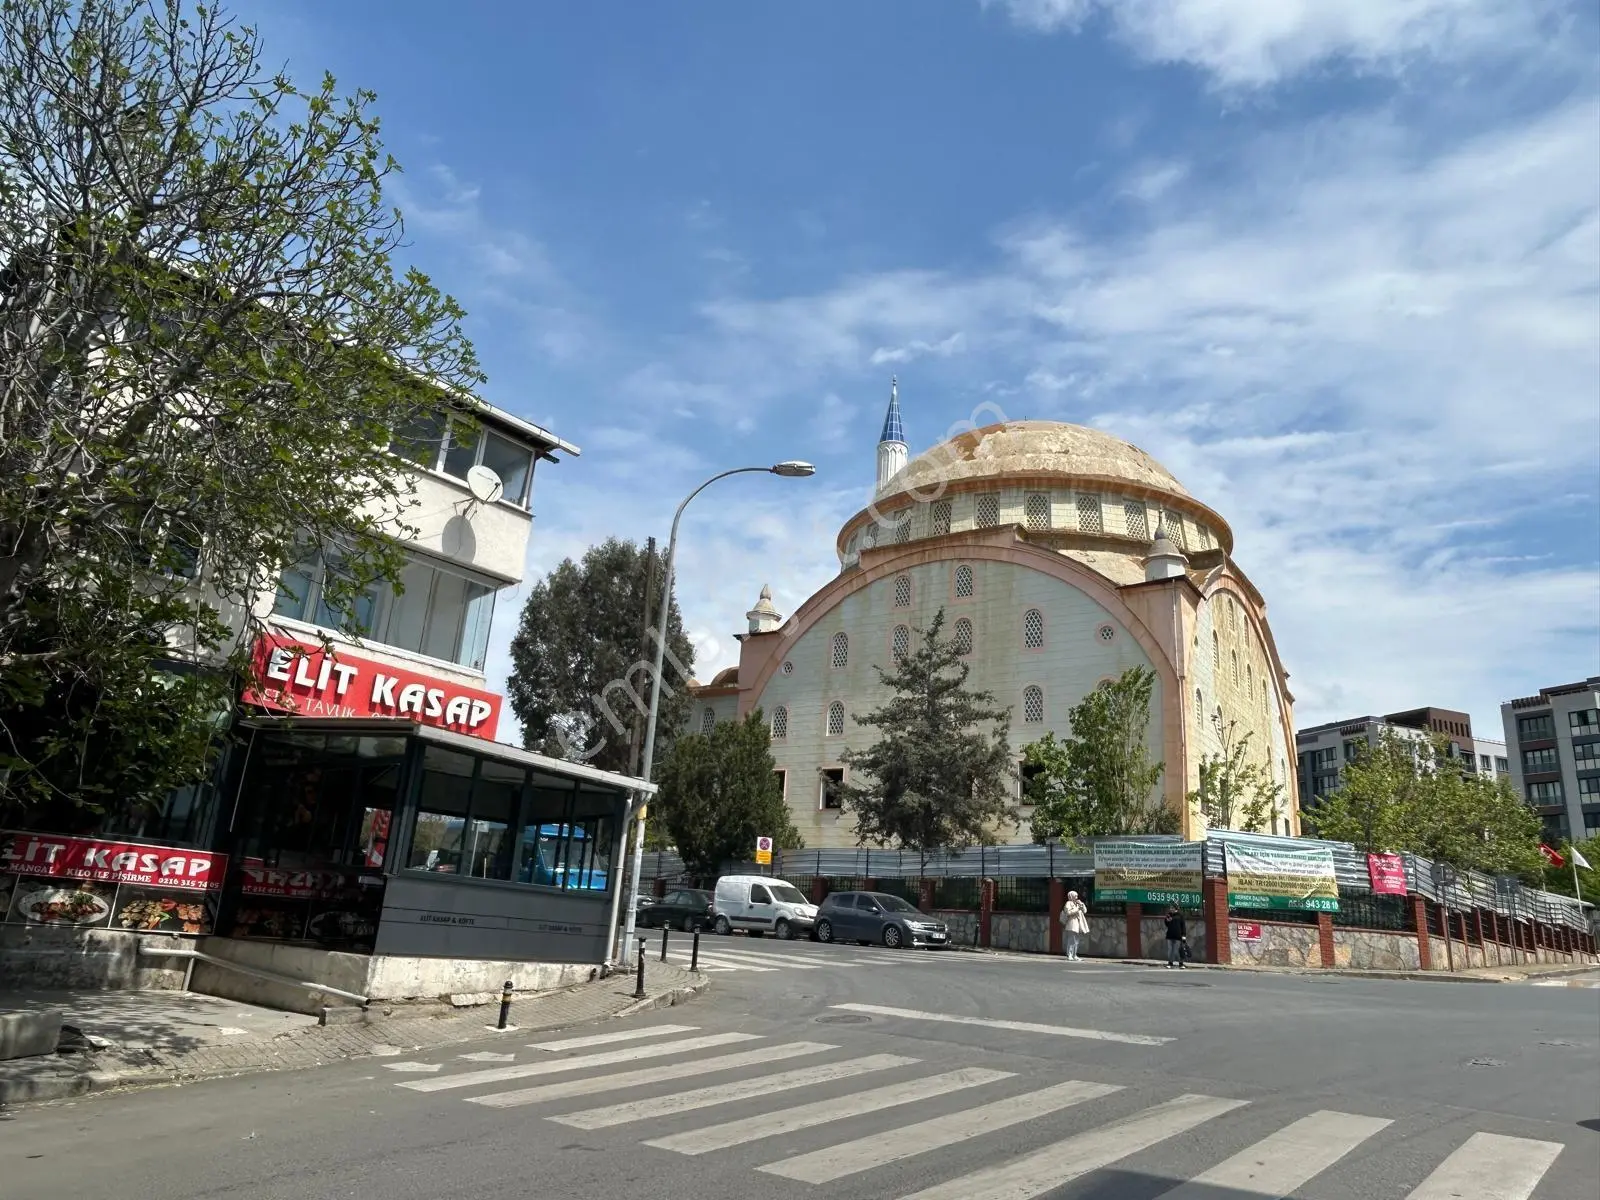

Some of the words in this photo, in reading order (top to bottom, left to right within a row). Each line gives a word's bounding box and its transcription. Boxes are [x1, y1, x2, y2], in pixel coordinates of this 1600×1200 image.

[267, 647, 358, 694] ELİT
[373, 674, 491, 727] KASAP
[305, 698, 356, 717] TAVUK
[84, 848, 211, 877] KASAP
[9, 863, 55, 874] MANGAL
[66, 868, 91, 877] KİLO
[94, 870, 109, 879] İLE
[112, 870, 152, 883] PİŞİRME
[158, 877, 179, 885] 0216
[181, 879, 196, 887] 315
[198, 880, 208, 888] 74
[1147, 892, 1165, 902] 0535
[1166, 893, 1179, 902] 943
[1181, 894, 1190, 903] 28
[1192, 895, 1200, 904] 10
[1305, 899, 1320, 909] 943
[1321, 900, 1331, 910] 28
